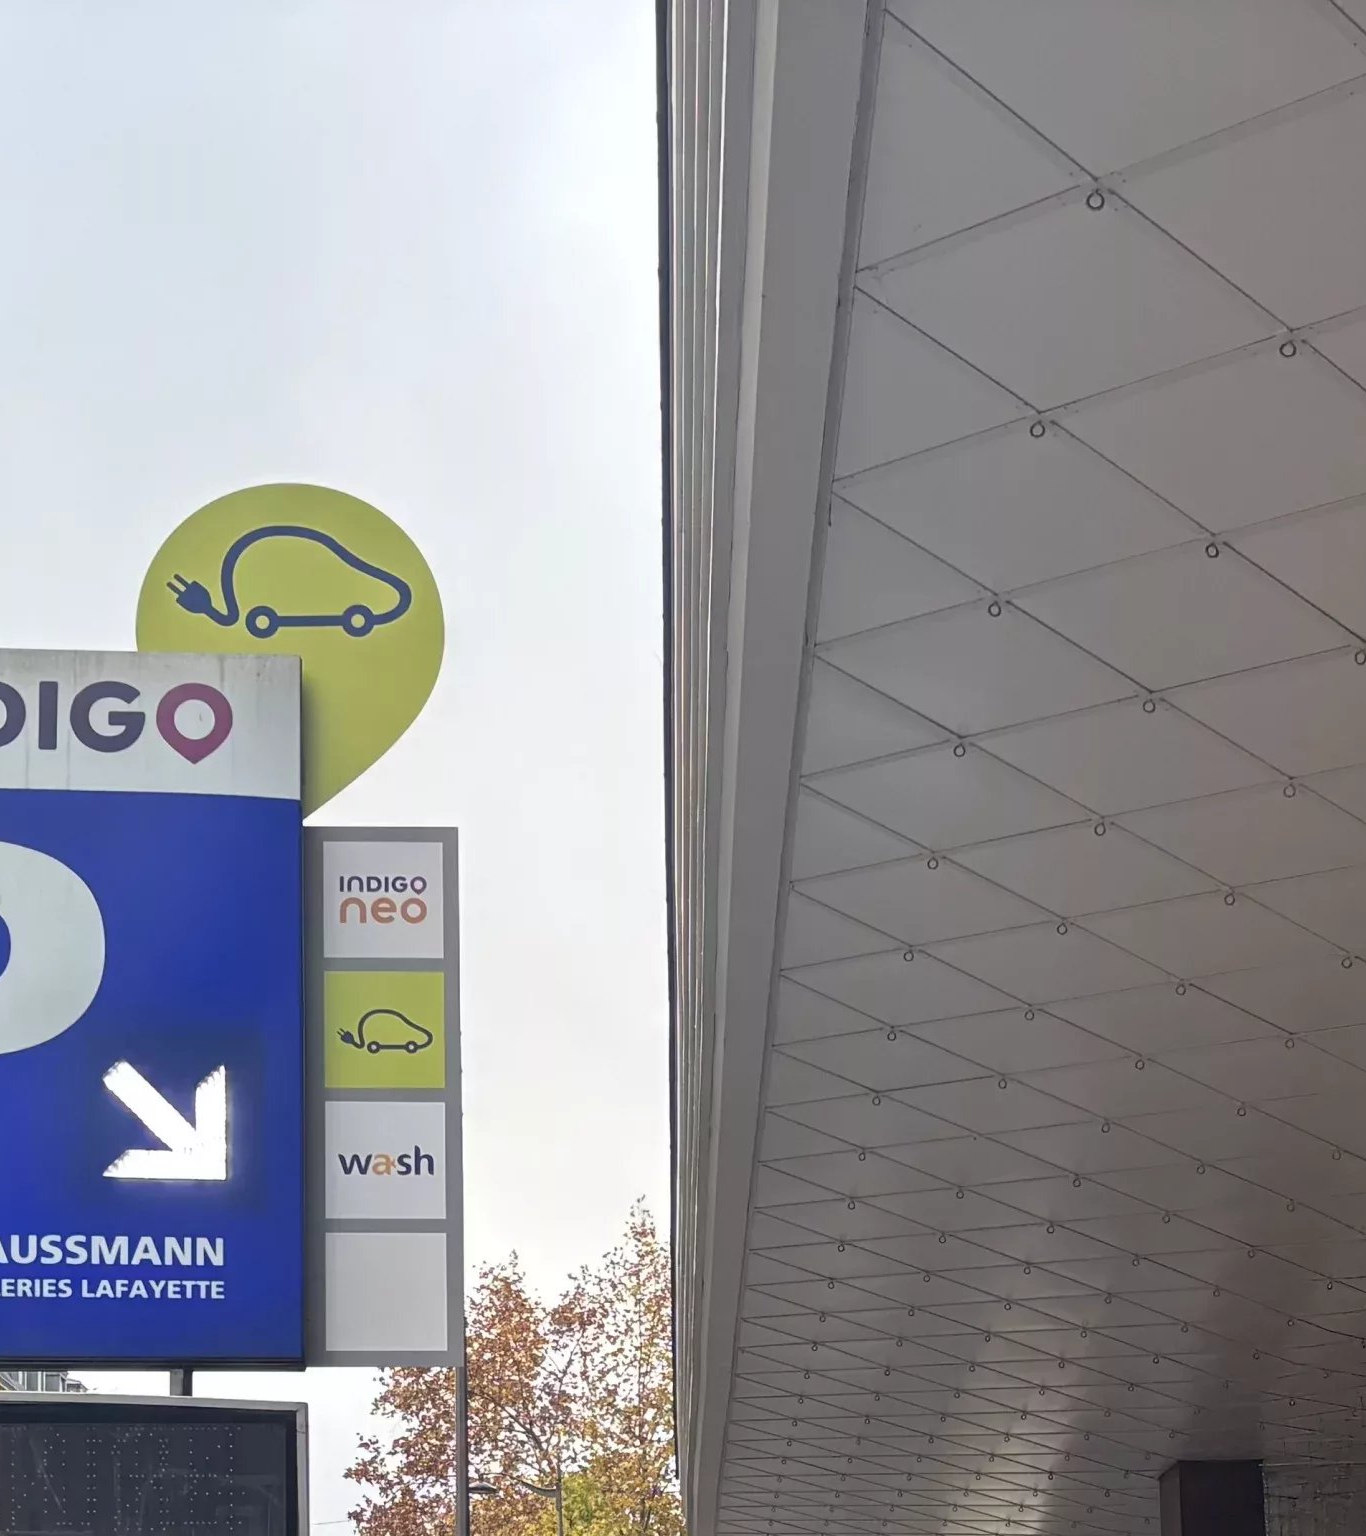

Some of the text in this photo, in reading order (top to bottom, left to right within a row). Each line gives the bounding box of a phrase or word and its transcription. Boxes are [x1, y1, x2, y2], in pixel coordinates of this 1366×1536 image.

[339, 875, 427, 895] INDIGO
[339, 897, 428, 924] neo
[338, 1146, 434, 1176] wash
[81, 1279, 225, 1300] LAFAYETTE
